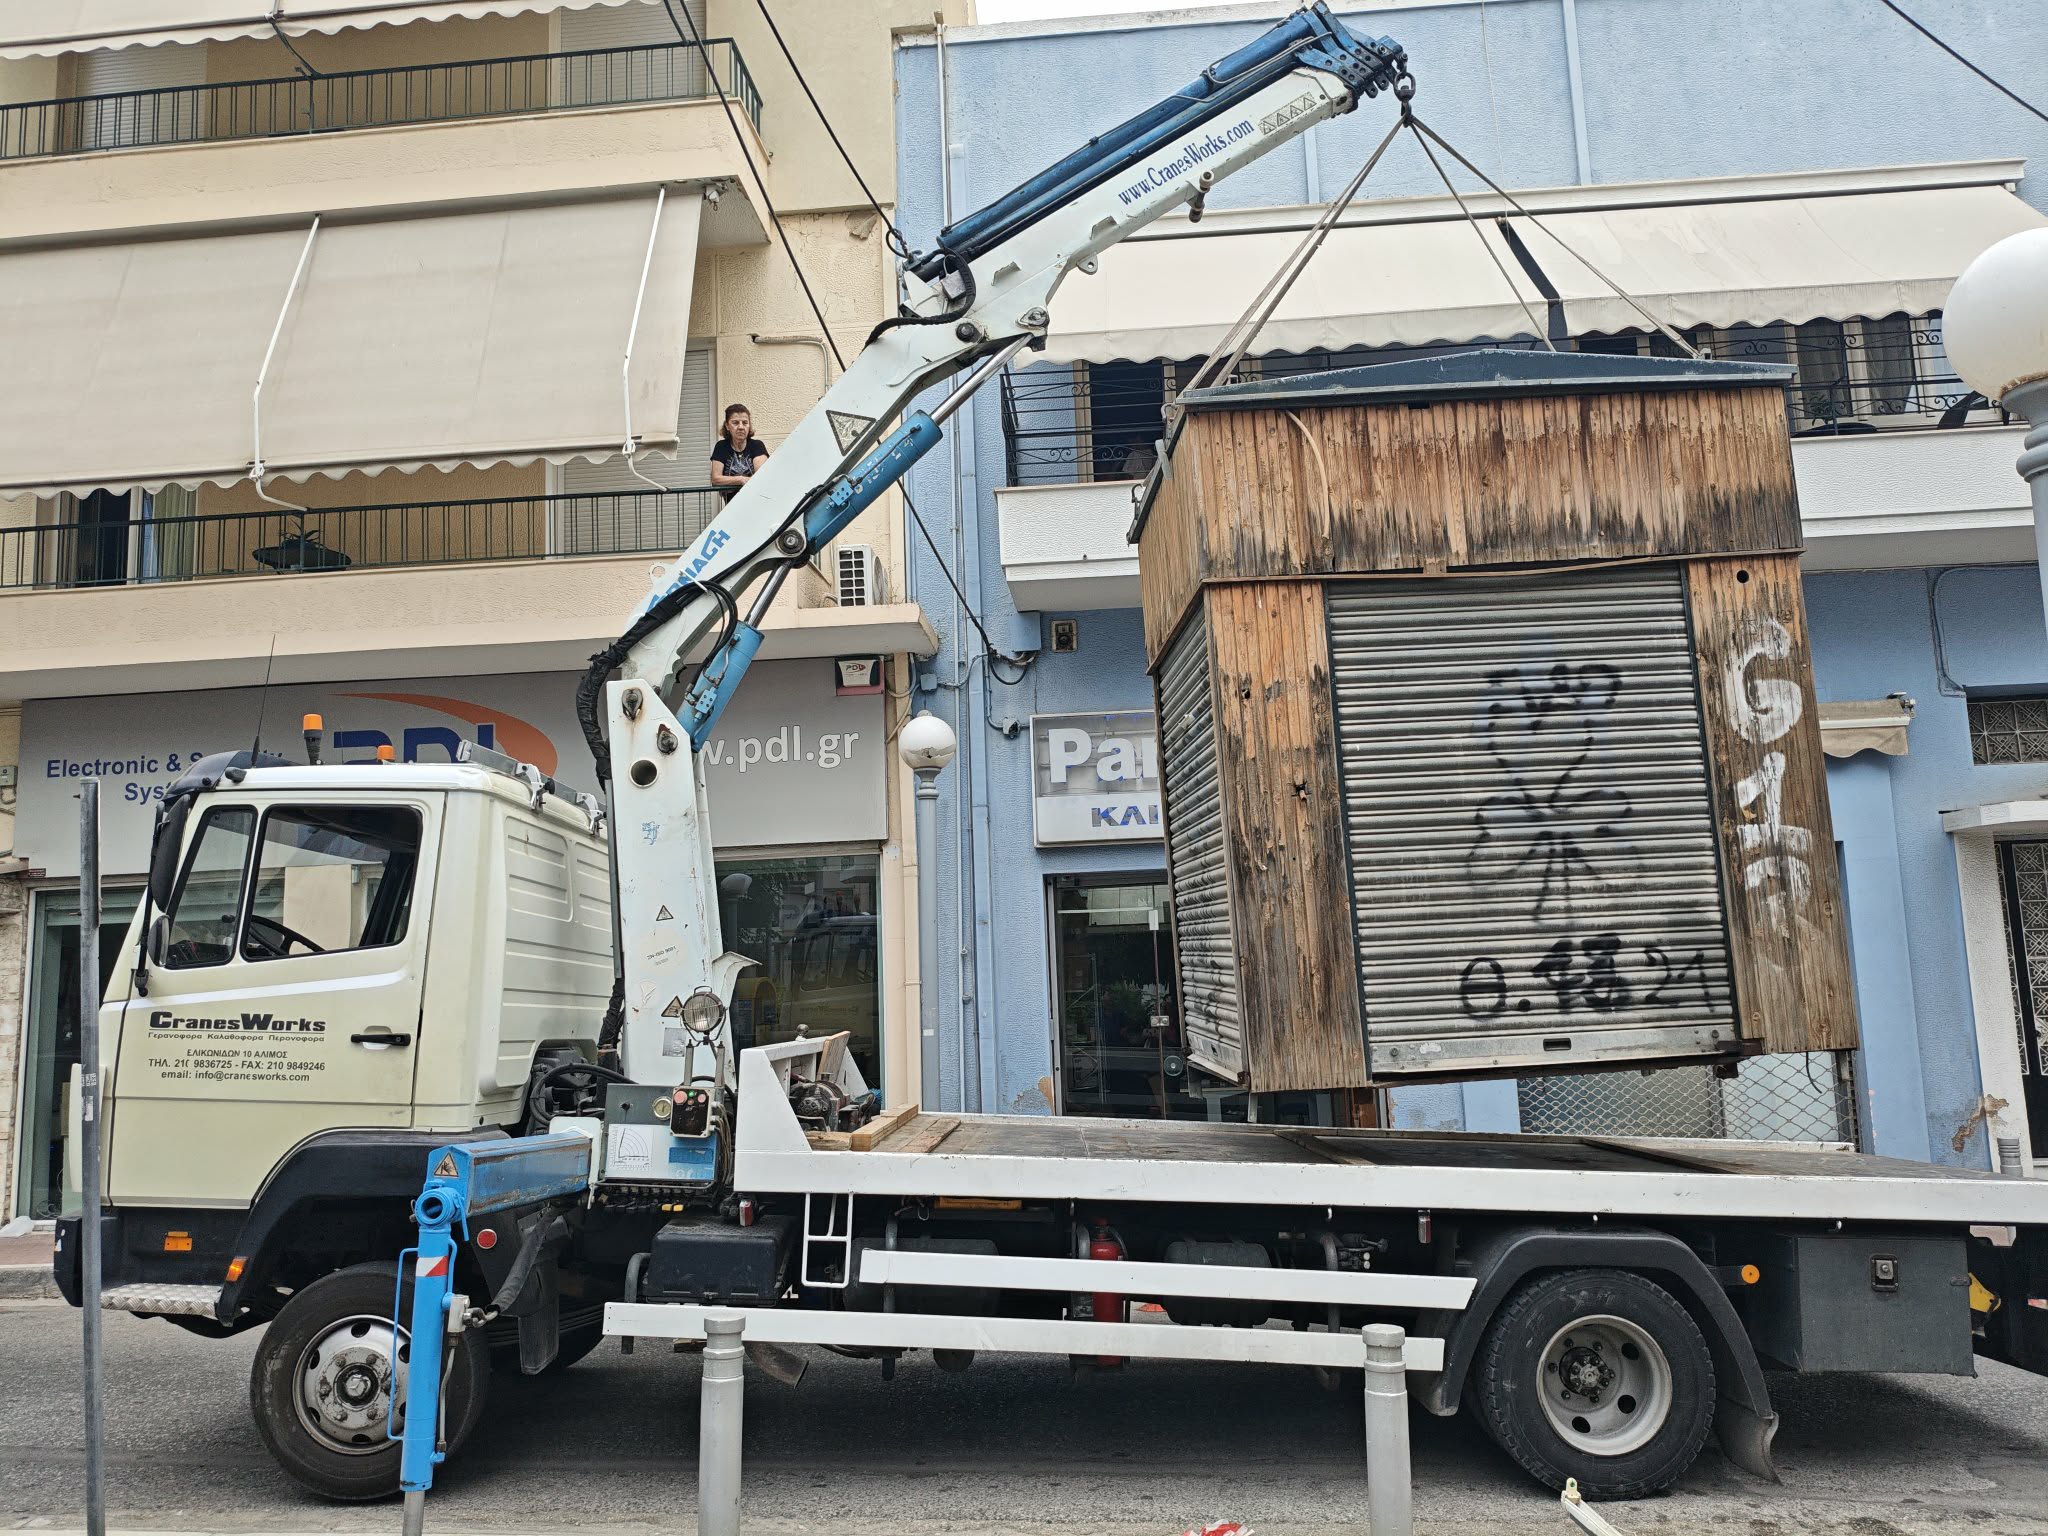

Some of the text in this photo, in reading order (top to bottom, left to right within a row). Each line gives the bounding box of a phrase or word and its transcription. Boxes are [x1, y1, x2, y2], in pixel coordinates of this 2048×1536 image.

[1118, 119, 1255, 206] www.CranesWorks.com
[46, 755, 159, 778] Electronic
[166, 752, 182, 772] &
[124, 781, 172, 806] Sys
[149, 1011, 326, 1032] CranesWorks
[148, 1032, 325, 1042] Γερανοφορα Καλαθοφορα Περονοφορα
[243, 1050, 252, 1058] 10
[253, 1050, 288, 1059] ΑΛΙΜΟΣ
[148, 1058, 171, 1068] ΤΗΛ.
[193, 1059, 233, 1069] 9836725
[241, 1060, 265, 1069] FAX:
[267, 1060, 284, 1070] 210
[286, 1061, 326, 1071] 9849246
[161, 1070, 310, 1082] email: info@cranesworks.com
